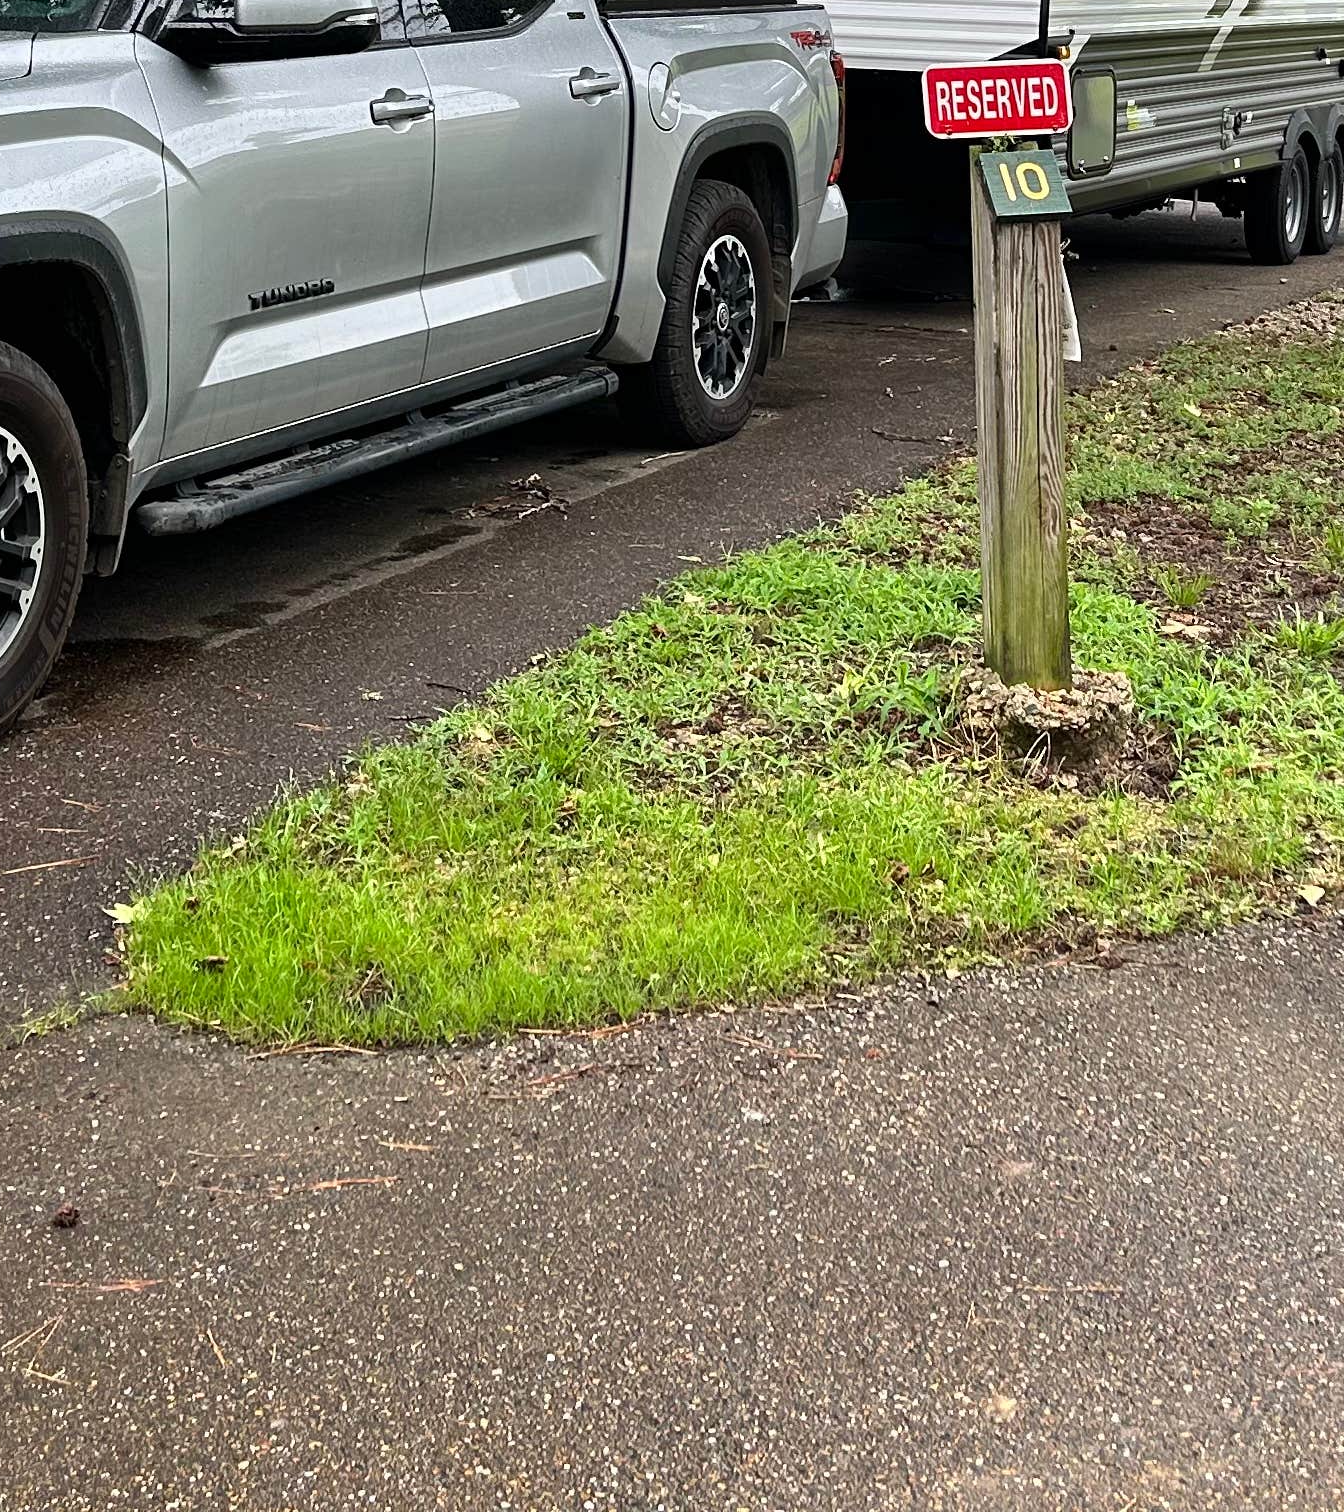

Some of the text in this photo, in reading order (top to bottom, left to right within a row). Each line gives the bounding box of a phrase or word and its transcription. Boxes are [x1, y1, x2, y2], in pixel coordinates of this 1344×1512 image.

[936, 76, 1059, 121] RESERVED
[999, 161, 1050, 202] 10
[247, 277, 335, 310] TUNDRA
